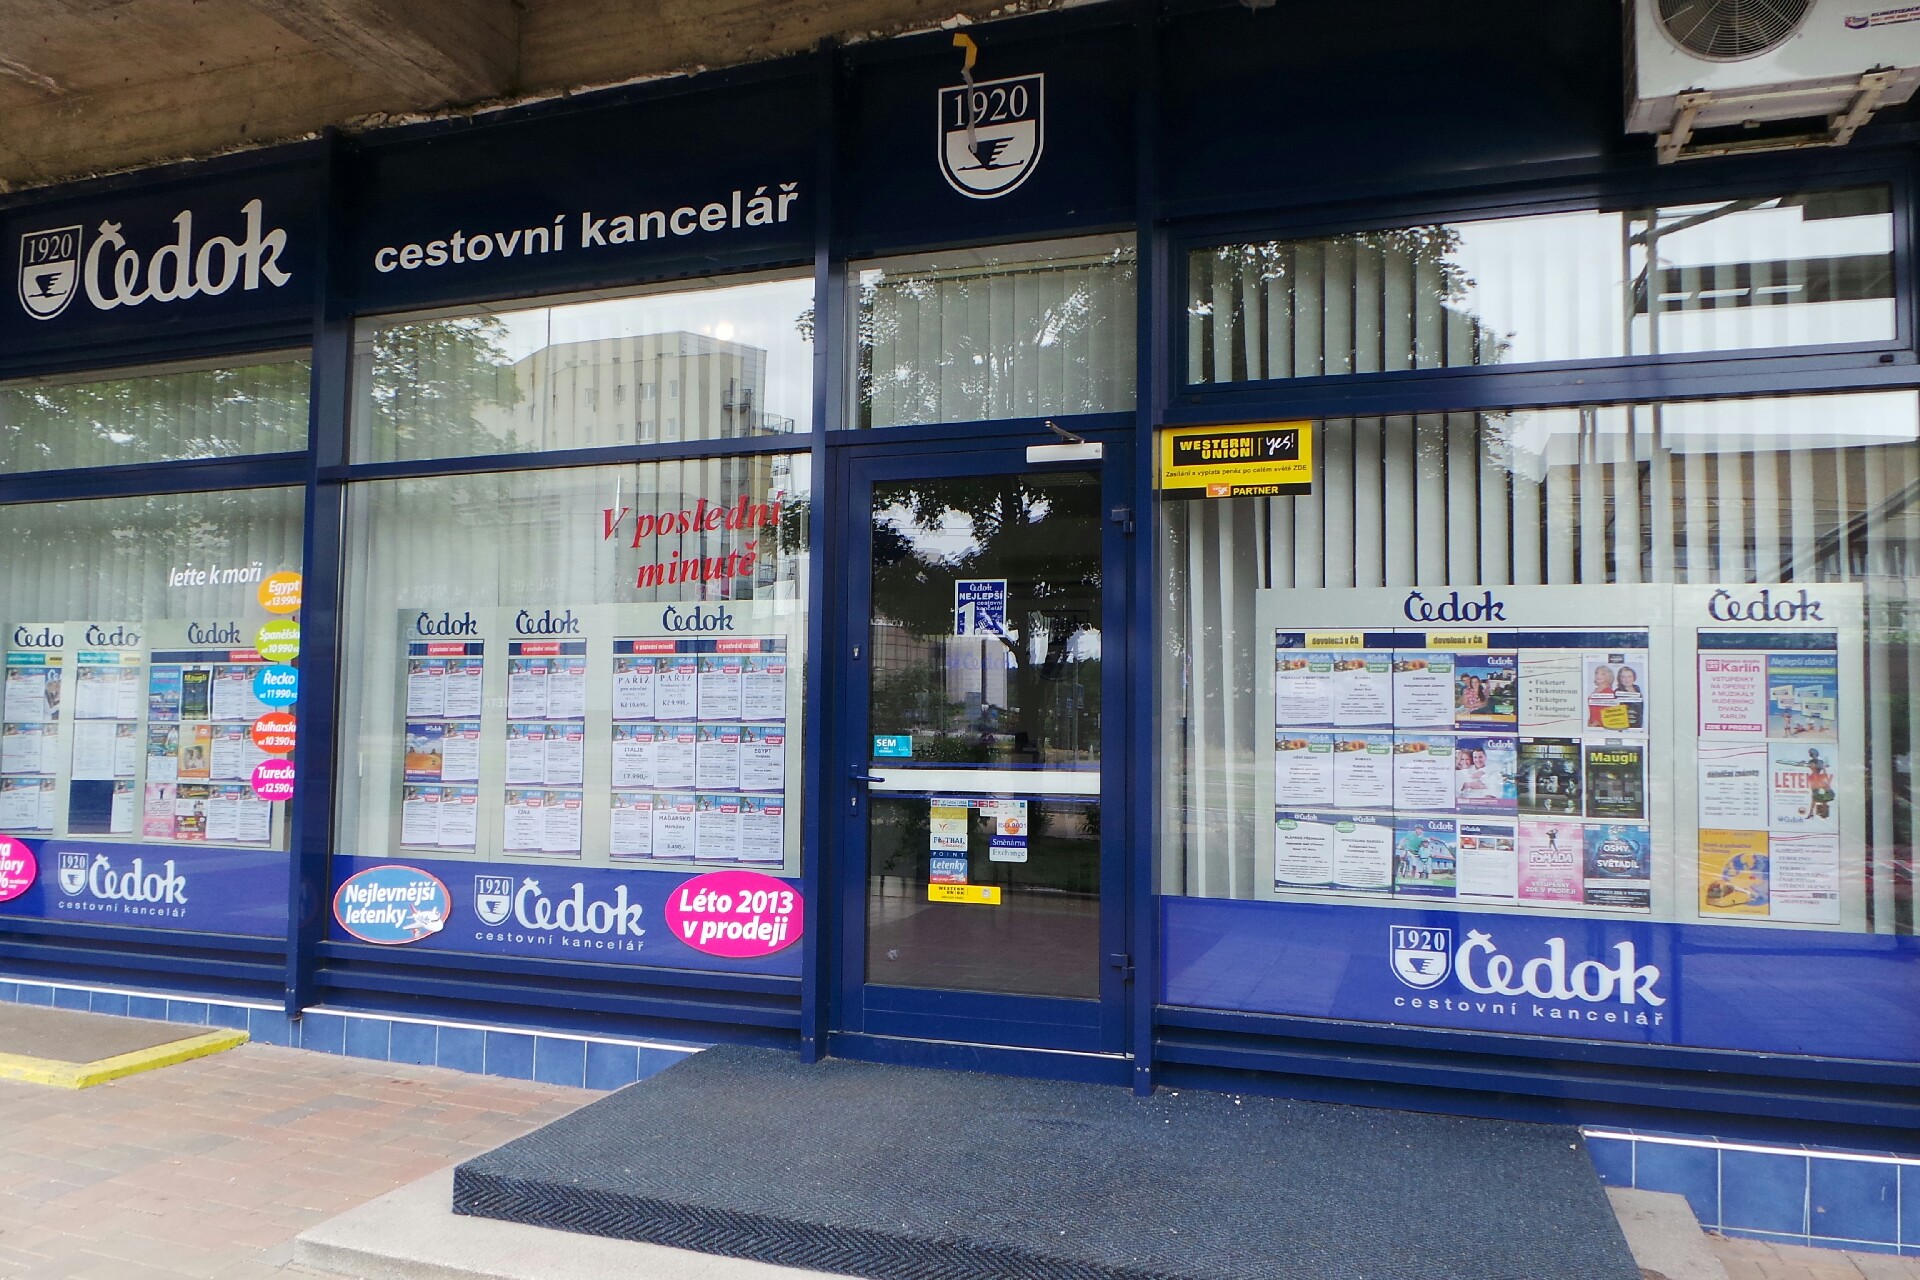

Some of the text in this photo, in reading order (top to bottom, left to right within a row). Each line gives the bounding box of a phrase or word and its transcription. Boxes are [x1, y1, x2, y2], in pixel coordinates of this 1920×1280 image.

[954, 84, 1028, 127] 1920
[374, 181, 799, 273] cestovní kancelář
[28, 198, 292, 310] 1920 Čedok
[1180, 432, 1294, 456] WESTERN yes!
[1202, 447, 1251, 459] UNION
[1233, 486, 1278, 496] PARTNER
[602, 490, 785, 548] V poslední
[209, 565, 220, 584] k
[222, 561, 262, 584] moři
[636, 540, 758, 588] minutě
[268, 580, 300, 596] Egypt
[959, 591, 1003, 600] NEJLEPŠÍ
[1404, 590, 1507, 622] Čedok
[1708, 588, 1825, 622] Čedok
[416, 612, 479, 636] Čedok
[515, 609, 580, 635] Čedok
[662, 604, 735, 631] Čedok
[188, 621, 241, 644] Čedok
[1433, 637, 1467, 645] dovolená
[263, 670, 295, 685] Řecko
[1721, 663, 1760, 672] Karlín
[876, 739, 897, 747] SEM
[1590, 752, 1638, 764] Maugli
[932, 860, 965, 871] Letenky
[992, 849, 1025, 858] Exchange
[1529, 851, 1573, 863] POMÁDA
[62, 854, 188, 904] 1920 Čedok
[344, 878, 437, 906] Nejlevnější
[679, 888, 794, 915] Léto 2013
[58, 900, 187, 918] cestovní kancelář
[345, 904, 408, 928] letenky
[478, 877, 646, 936] 1920 Čedok
[475, 930, 645, 952] cestovní kancelář
[682, 916, 789, 947] v prodeji
[1397, 928, 1667, 1007] 1920 Čedok
[1394, 995, 1664, 1026] cestovní kancelář
